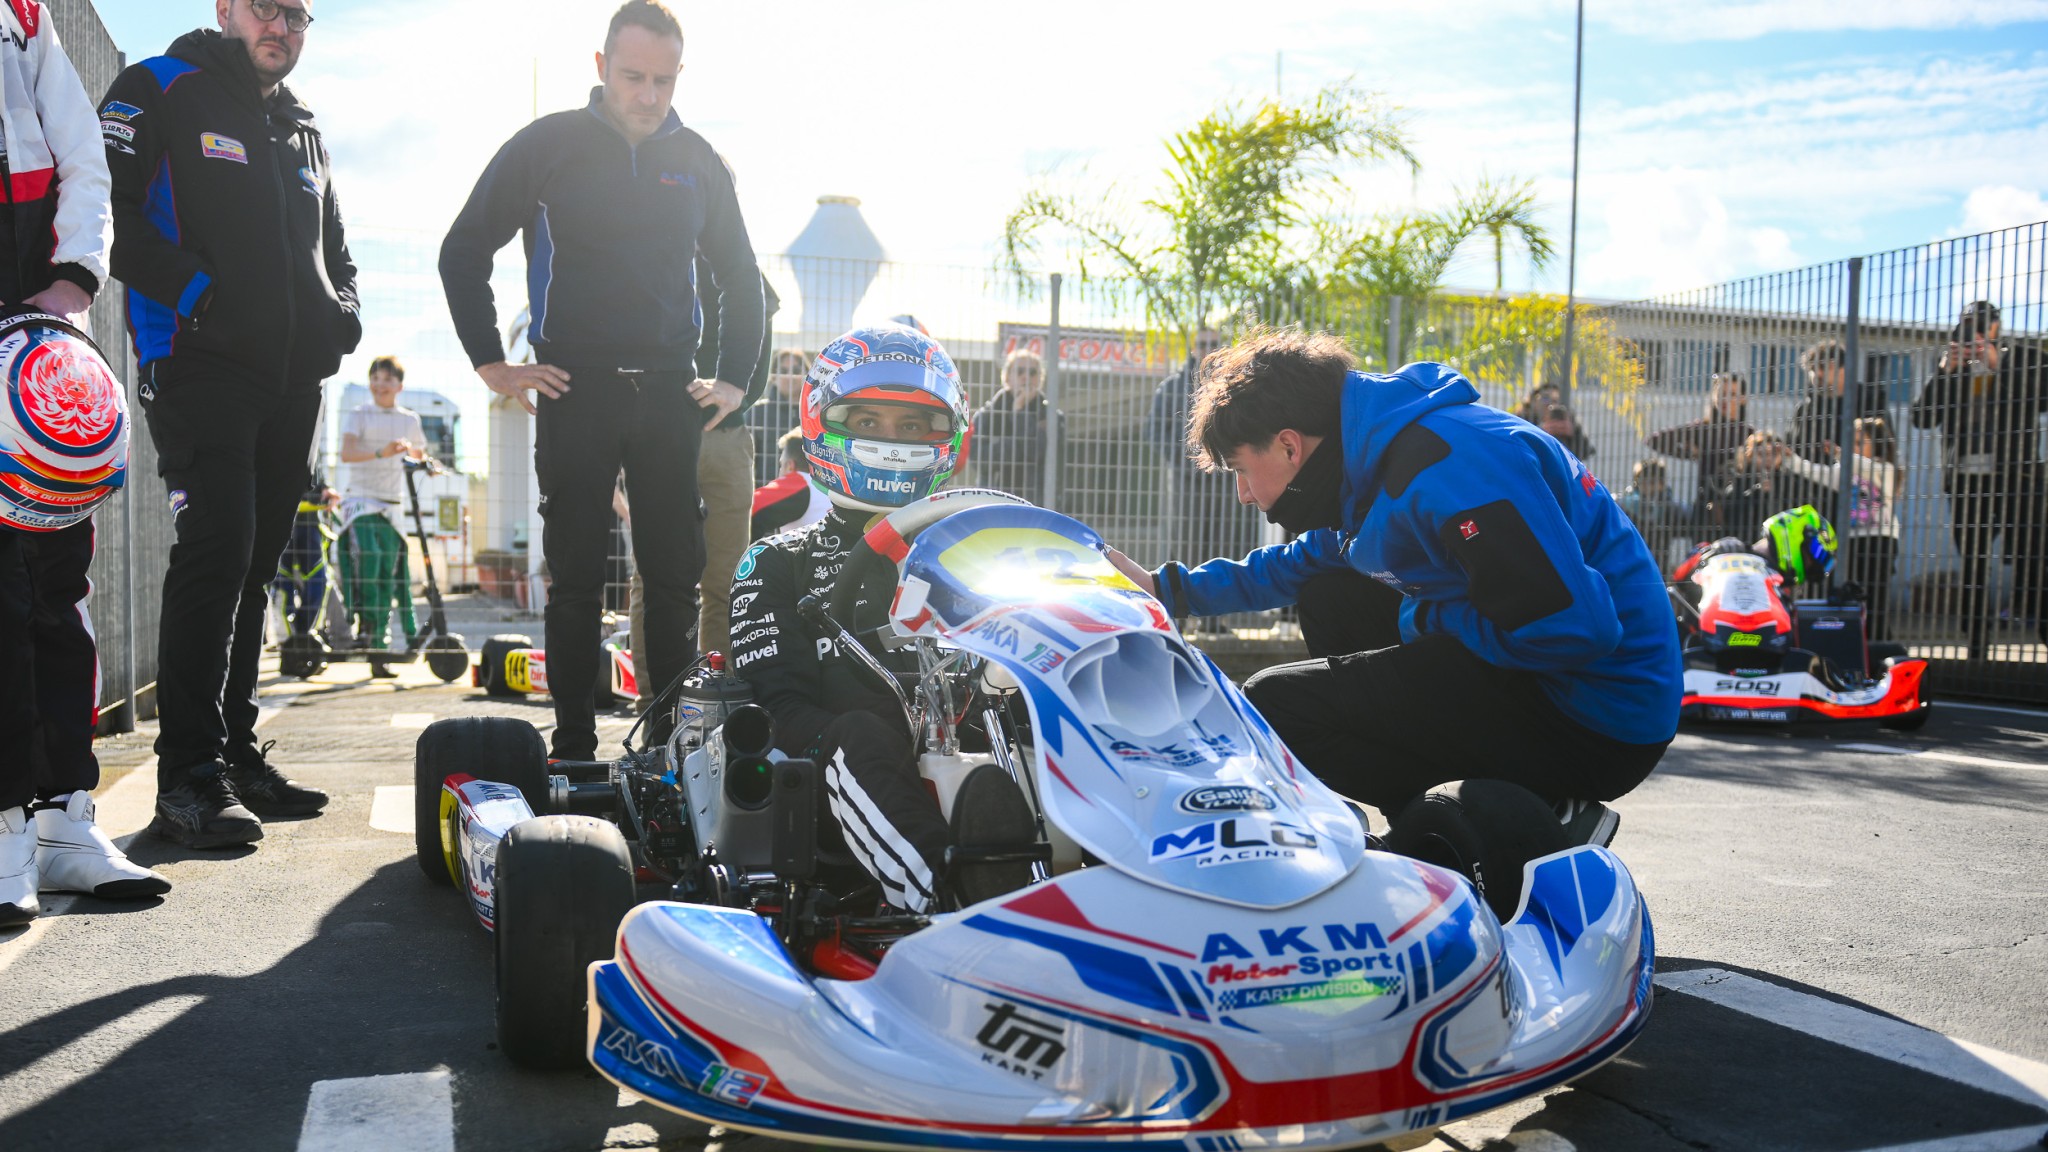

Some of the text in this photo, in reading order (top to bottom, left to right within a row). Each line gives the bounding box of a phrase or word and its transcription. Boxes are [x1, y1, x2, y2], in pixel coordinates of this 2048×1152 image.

[853, 352, 935, 371] PETRONAS
[883, 456, 907, 464] WhatsApp
[18, 483, 40, 497] THE
[867, 476, 918, 494] nuvei
[733, 597, 751, 614] SAP
[736, 639, 778, 669] nuvei
[1198, 850, 1296, 866] RACING
[1201, 922, 1388, 963] AKM
[1245, 979, 1375, 1004] KART DIVISION
[981, 1052, 1044, 1081] KART
[698, 1060, 769, 1110] 12
